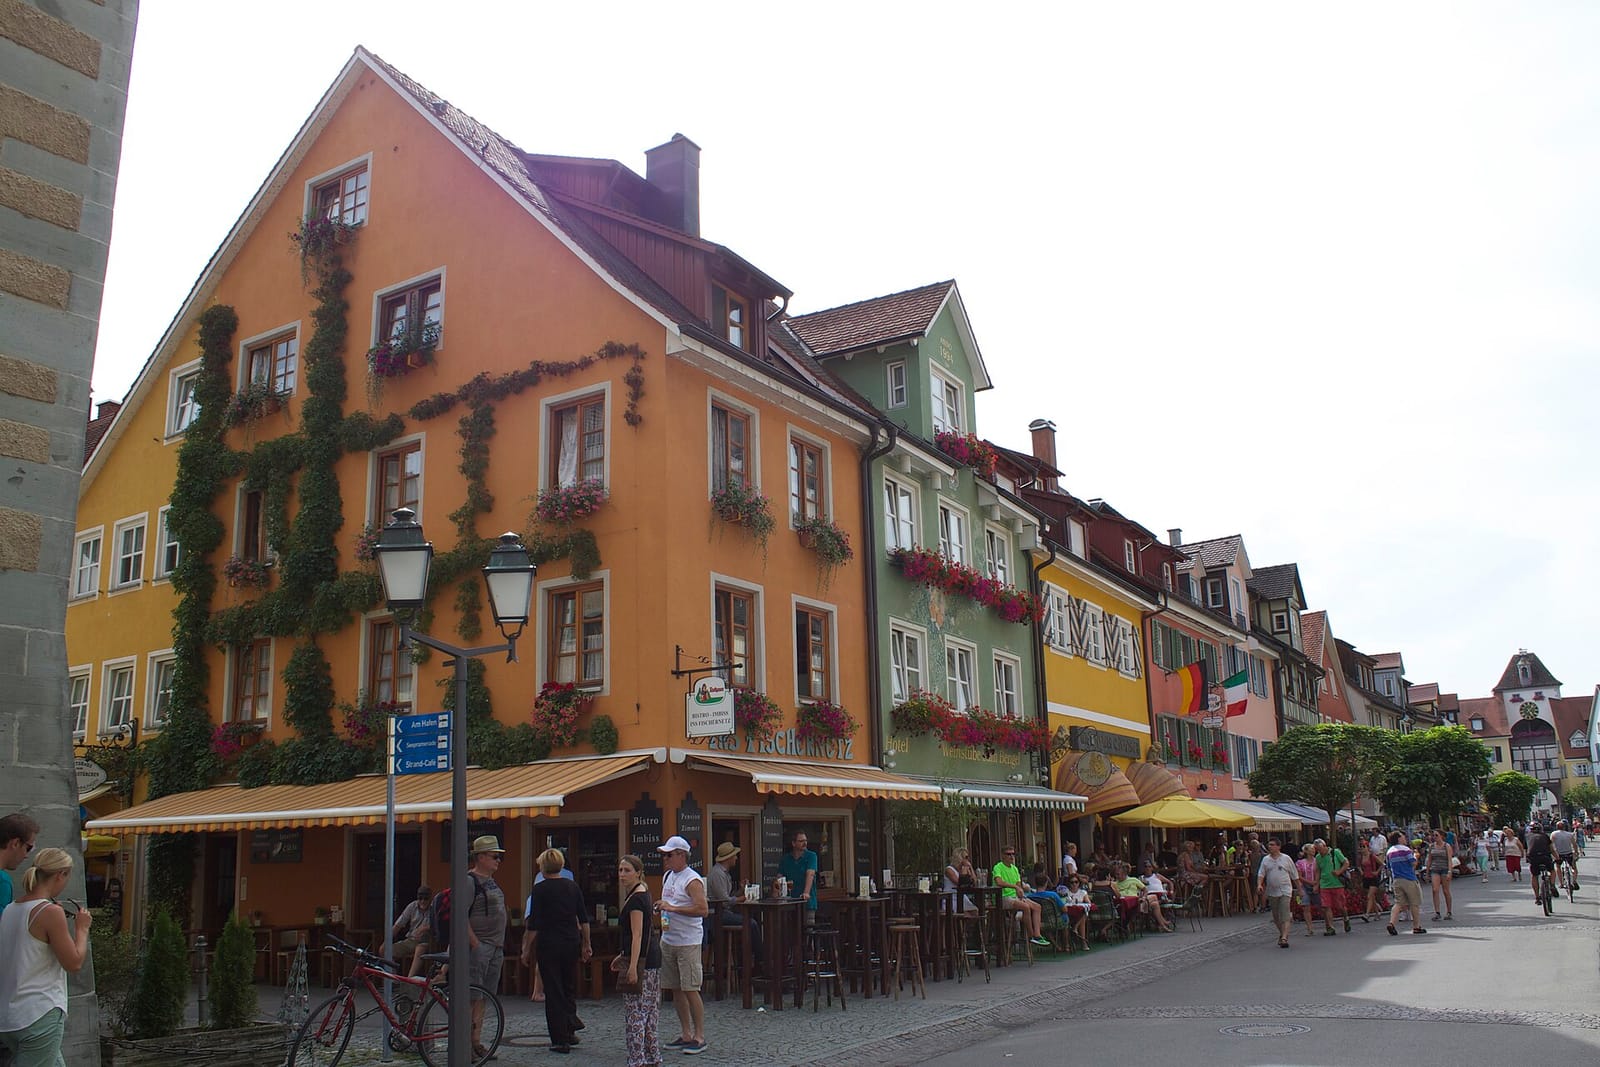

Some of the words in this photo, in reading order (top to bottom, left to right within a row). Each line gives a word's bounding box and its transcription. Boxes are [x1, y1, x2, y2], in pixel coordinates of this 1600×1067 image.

[885, 735, 909, 753] Hotel
[633, 816, 659, 825] Bistro
[680, 824, 700, 832] Zimmer
[632, 833, 660, 843] Imbiss
